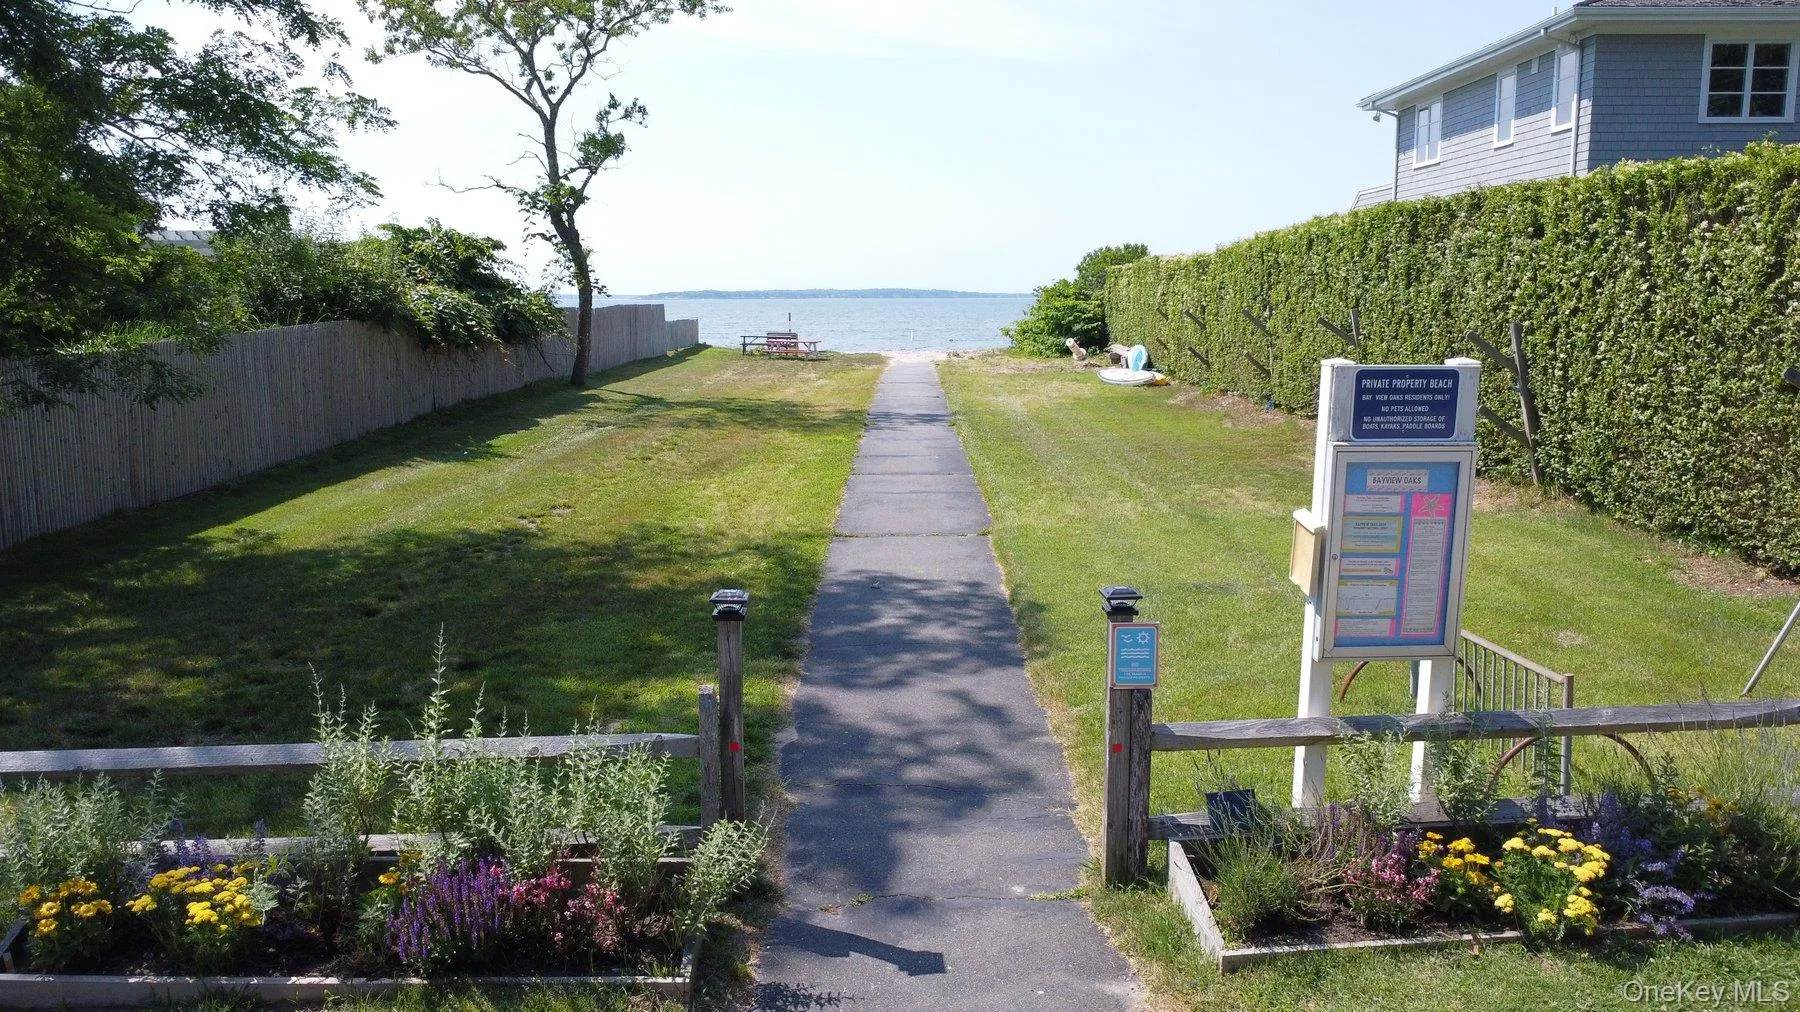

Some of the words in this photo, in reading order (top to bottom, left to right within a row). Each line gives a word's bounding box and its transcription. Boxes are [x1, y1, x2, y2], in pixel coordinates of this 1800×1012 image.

[1361, 379, 1389, 389] PRIVATE
[1392, 379, 1428, 389] PROPERTY
[1429, 379, 1453, 389] BEACH
[1372, 476, 1402, 485] BAYVIEW
[1403, 476, 1422, 485] OAKS
